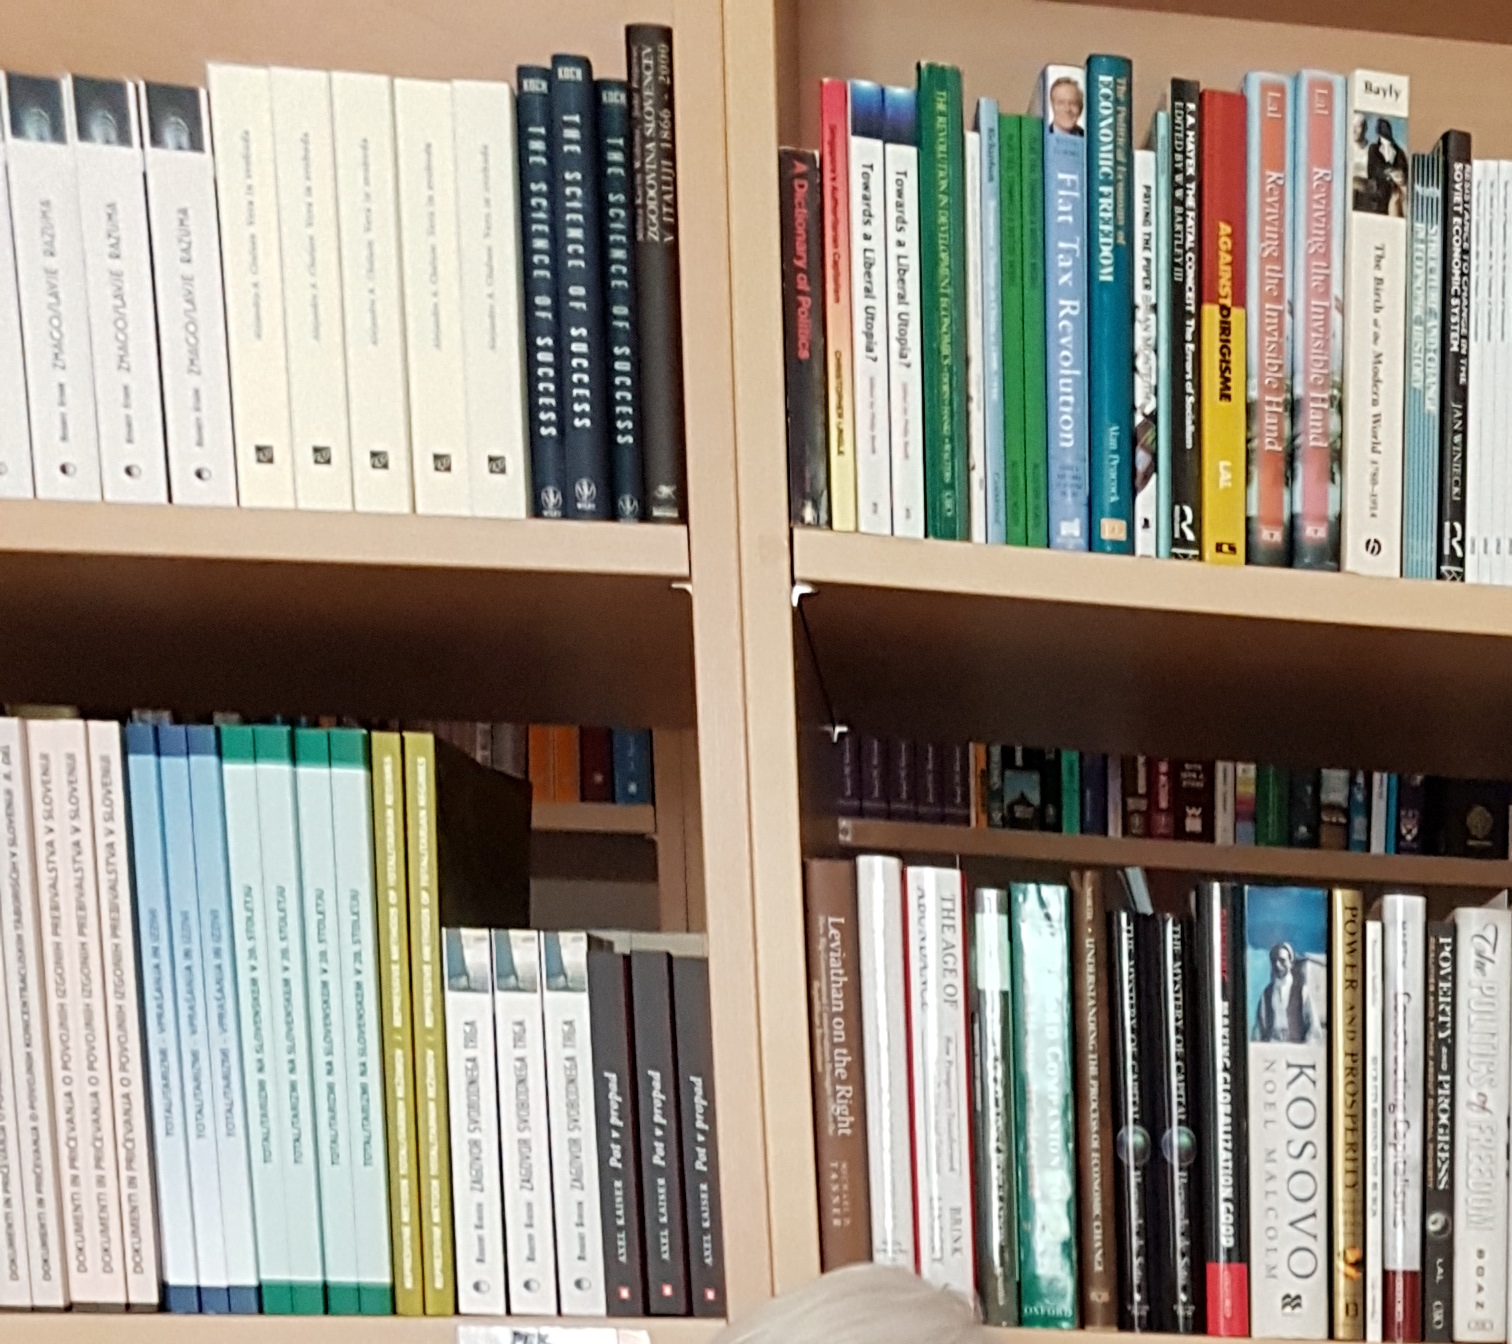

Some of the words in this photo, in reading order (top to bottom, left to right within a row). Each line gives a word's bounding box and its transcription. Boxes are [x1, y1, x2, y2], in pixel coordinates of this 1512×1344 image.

[658, 43, 671, 84] 2000
[1362, 79, 1402, 96] Bayly
[641, 44, 655, 136] SLOVENCEV
[1314, 88, 1328, 115] Lal
[563, 113, 581, 153] THE
[660, 108, 672, 148] 1866
[1098, 75, 1114, 180] ECONOMIC
[1185, 130, 1196, 175] HAYEK
[606, 137, 624, 175] THE
[793, 161, 808, 174] A
[643, 140, 659, 242] ZGODOVINA
[662, 160, 675, 222] ITALIJI
[894, 170, 909, 235] Towards
[1058, 172, 1079, 225] Flat
[1142, 184, 1152, 227] PAYING
[1185, 181, 1196, 207] THE
[1307, 167, 1330, 255] Reviving
[565, 171, 584, 268] SCIENCE
[608, 193, 628, 288] SCIENCE
[663, 232, 676, 242] V
[793, 179, 809, 271] Dictionary
[895, 240, 907, 249] a
[1098, 185, 1115, 282] FREEDOM
[1142, 232, 1152, 252] THE
[1184, 209, 1196, 249] FATAL
[797, 273, 811, 292] of
[895, 254, 910, 306] Liberal
[1058, 237, 1078, 287] Tax
[1141, 257, 1153, 291] PIPER
[1184, 252, 1196, 313] CONCEIT
[1218, 221, 1232, 305] AGAINST
[1311, 261, 1330, 291] the
[569, 286, 586, 309] OF
[612, 307, 630, 329] OF
[797, 296, 812, 361] Politics
[894, 312, 911, 368] Utopia?
[1217, 305, 1232, 402] DIRIGISME
[1308, 299, 1330, 385] Invisible
[570, 326, 590, 427] SUCCESS
[614, 346, 634, 443] SUCCESS
[1058, 300, 1079, 448] Revolution
[1308, 390, 1329, 447] Hand
[1218, 460, 1232, 489] LAL
[940, 894, 955, 935] THE
[826, 917, 846, 1011] Leviathan
[941, 939, 956, 978] AGE
[1345, 905, 1359, 991] POWER
[1473, 923, 1498, 976] The
[943, 983, 958, 1008] OF
[1438, 937, 1452, 1040] POVERTY
[831, 1017, 844, 1044] on
[1345, 1004, 1358, 1041] AND
[1467, 982, 1500, 1089] POLITICS
[832, 1049, 848, 1079] the
[603, 1072, 622, 1125] propad
[647, 1070, 666, 1124] propad
[831, 1085, 852, 1136] Right
[1264, 1060, 1277, 1129] NOEL
[1474, 1091, 1491, 1111] of
[611, 1131, 621, 1139] v
[1345, 1052, 1359, 1191] PROSPERITY
[1436, 1075, 1450, 1190] PROGRESS
[608, 1143, 623, 1169] Pot
[651, 1140, 666, 1167] Pot
[1286, 1060, 1318, 1280] KOSOVO
[1466, 1120, 1496, 1231] FREEDOM
[655, 1177, 667, 1223] KAISER
[1264, 1148, 1277, 1280] MALCOLM
[657, 1229, 670, 1260] AXEL
